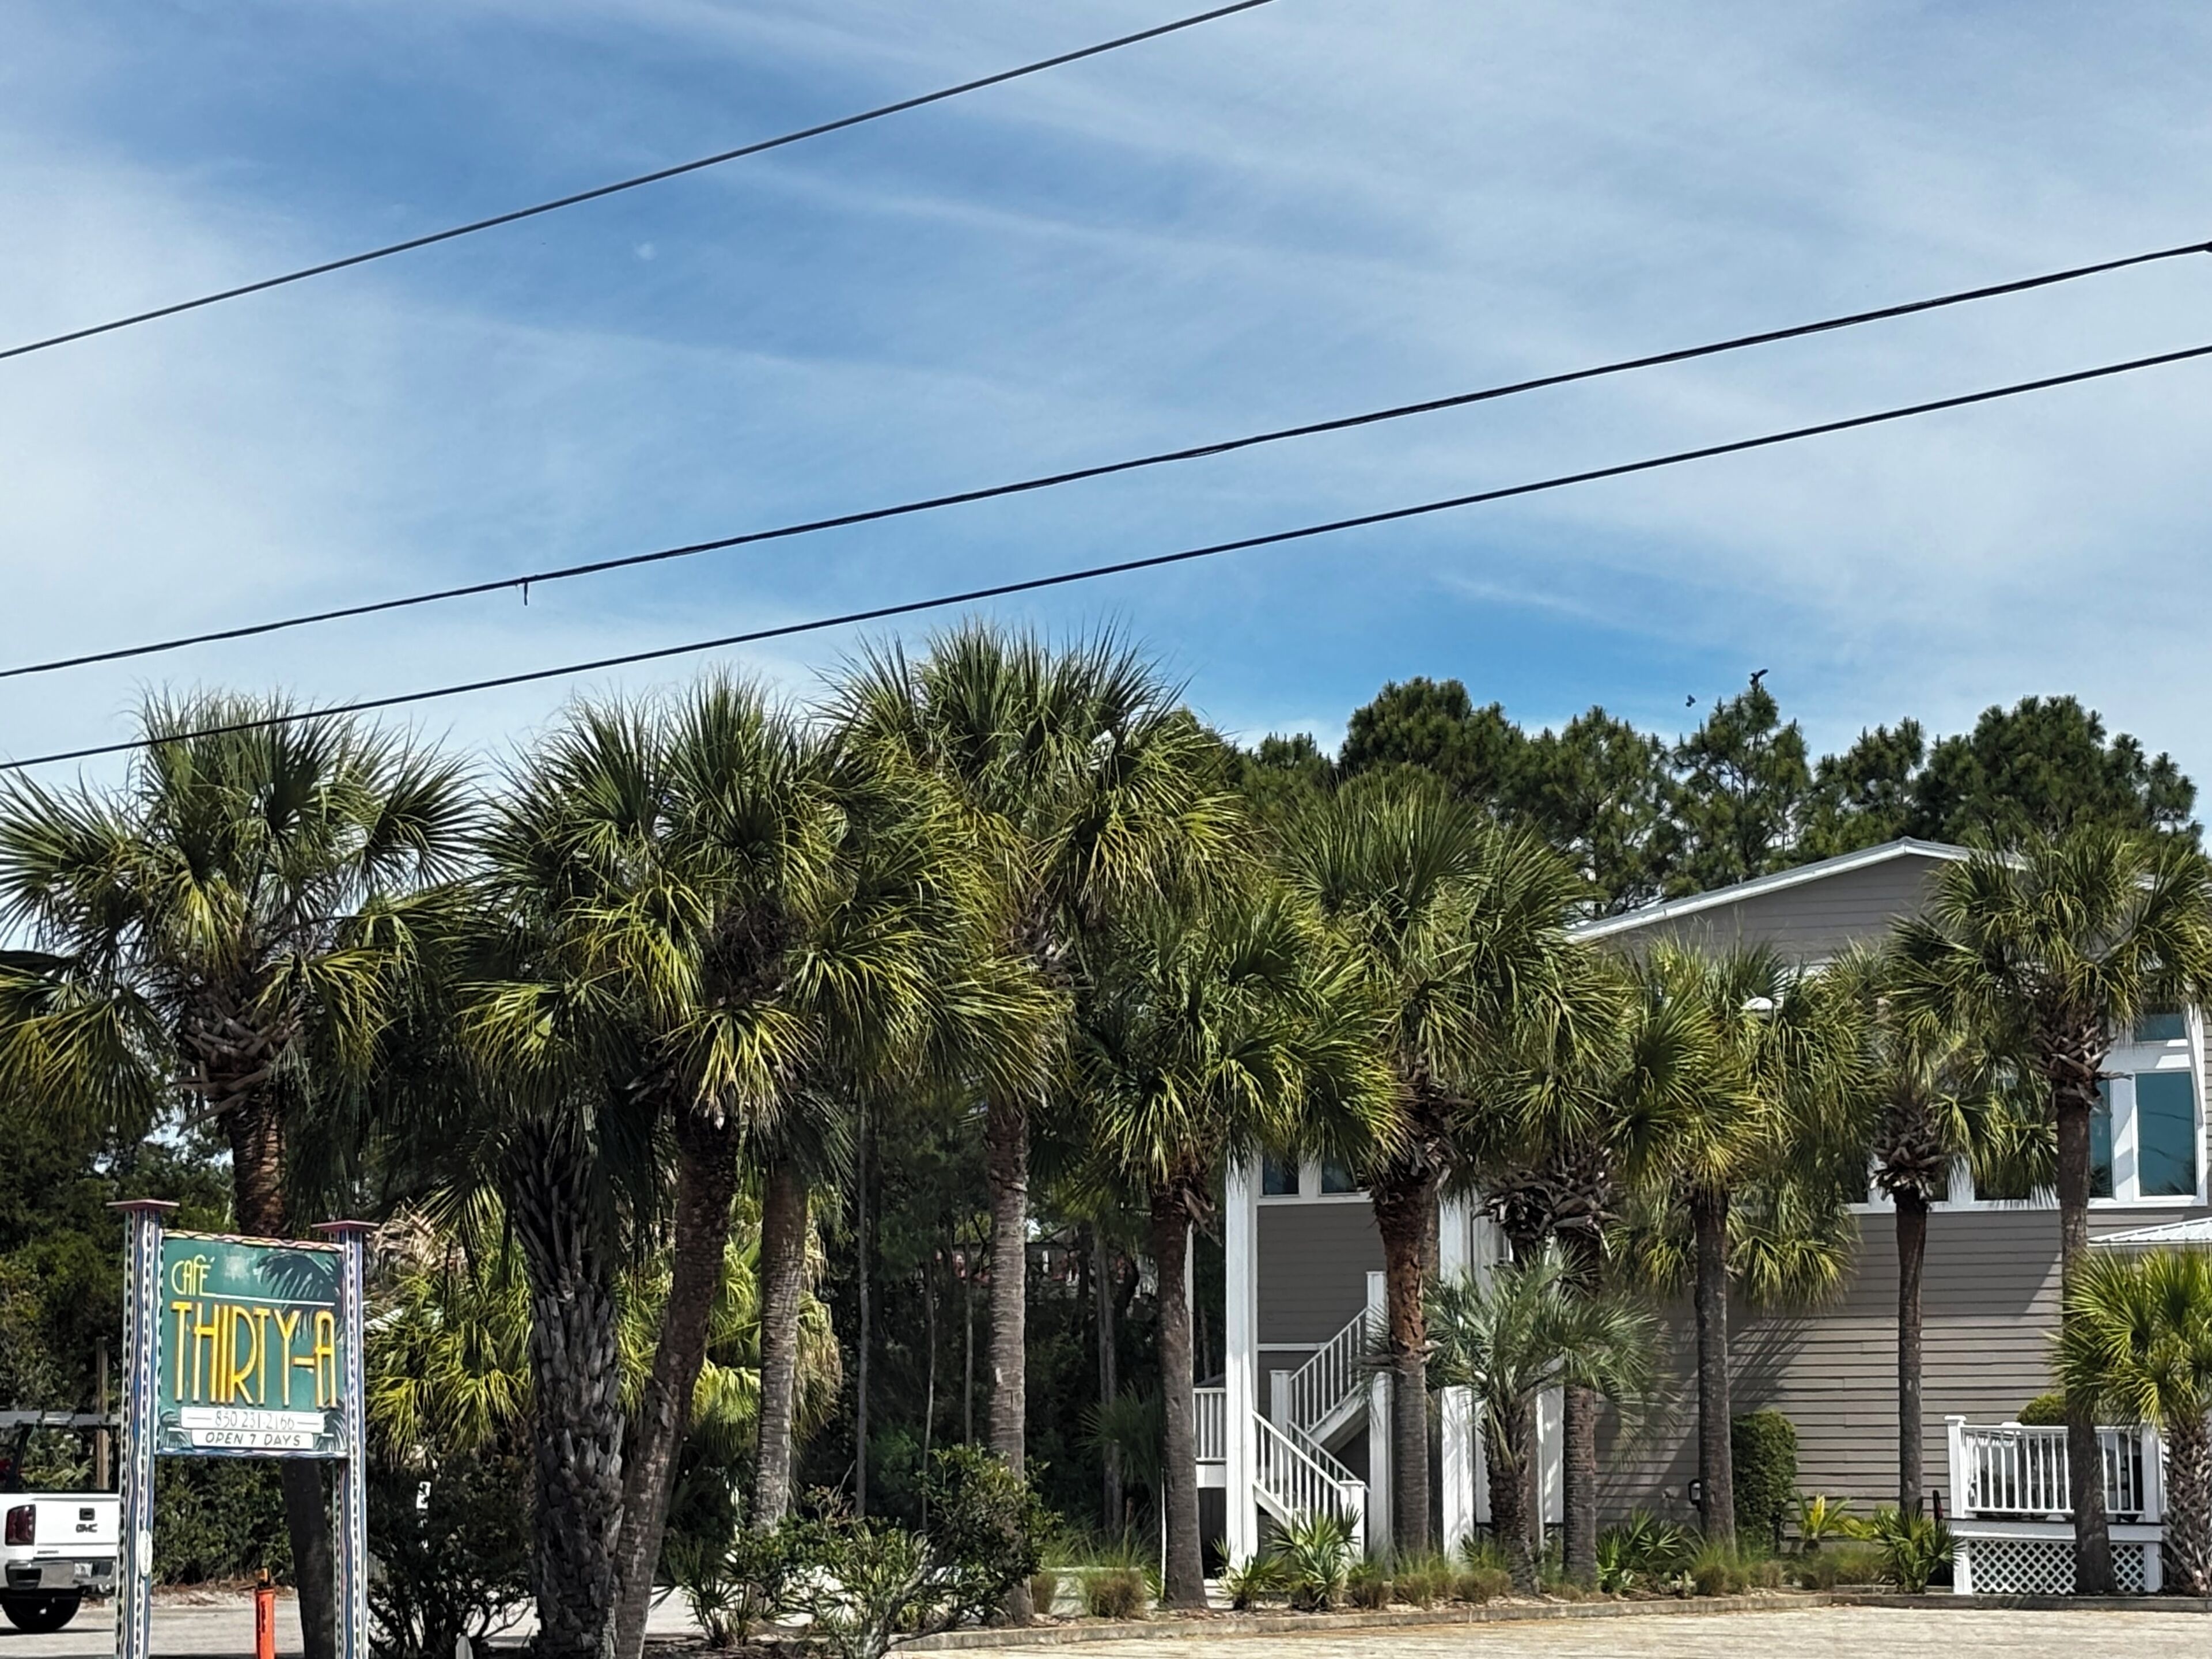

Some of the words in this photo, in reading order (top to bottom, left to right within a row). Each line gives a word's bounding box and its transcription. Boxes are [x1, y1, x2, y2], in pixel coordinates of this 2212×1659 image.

[171, 1301, 336, 1409] THIRTY-A
[215, 1410, 237, 1427] 850
[206, 1432, 244, 1445] OPEN
[249, 1434, 257, 1445] 7
[264, 1434, 301, 1446] DAYS
